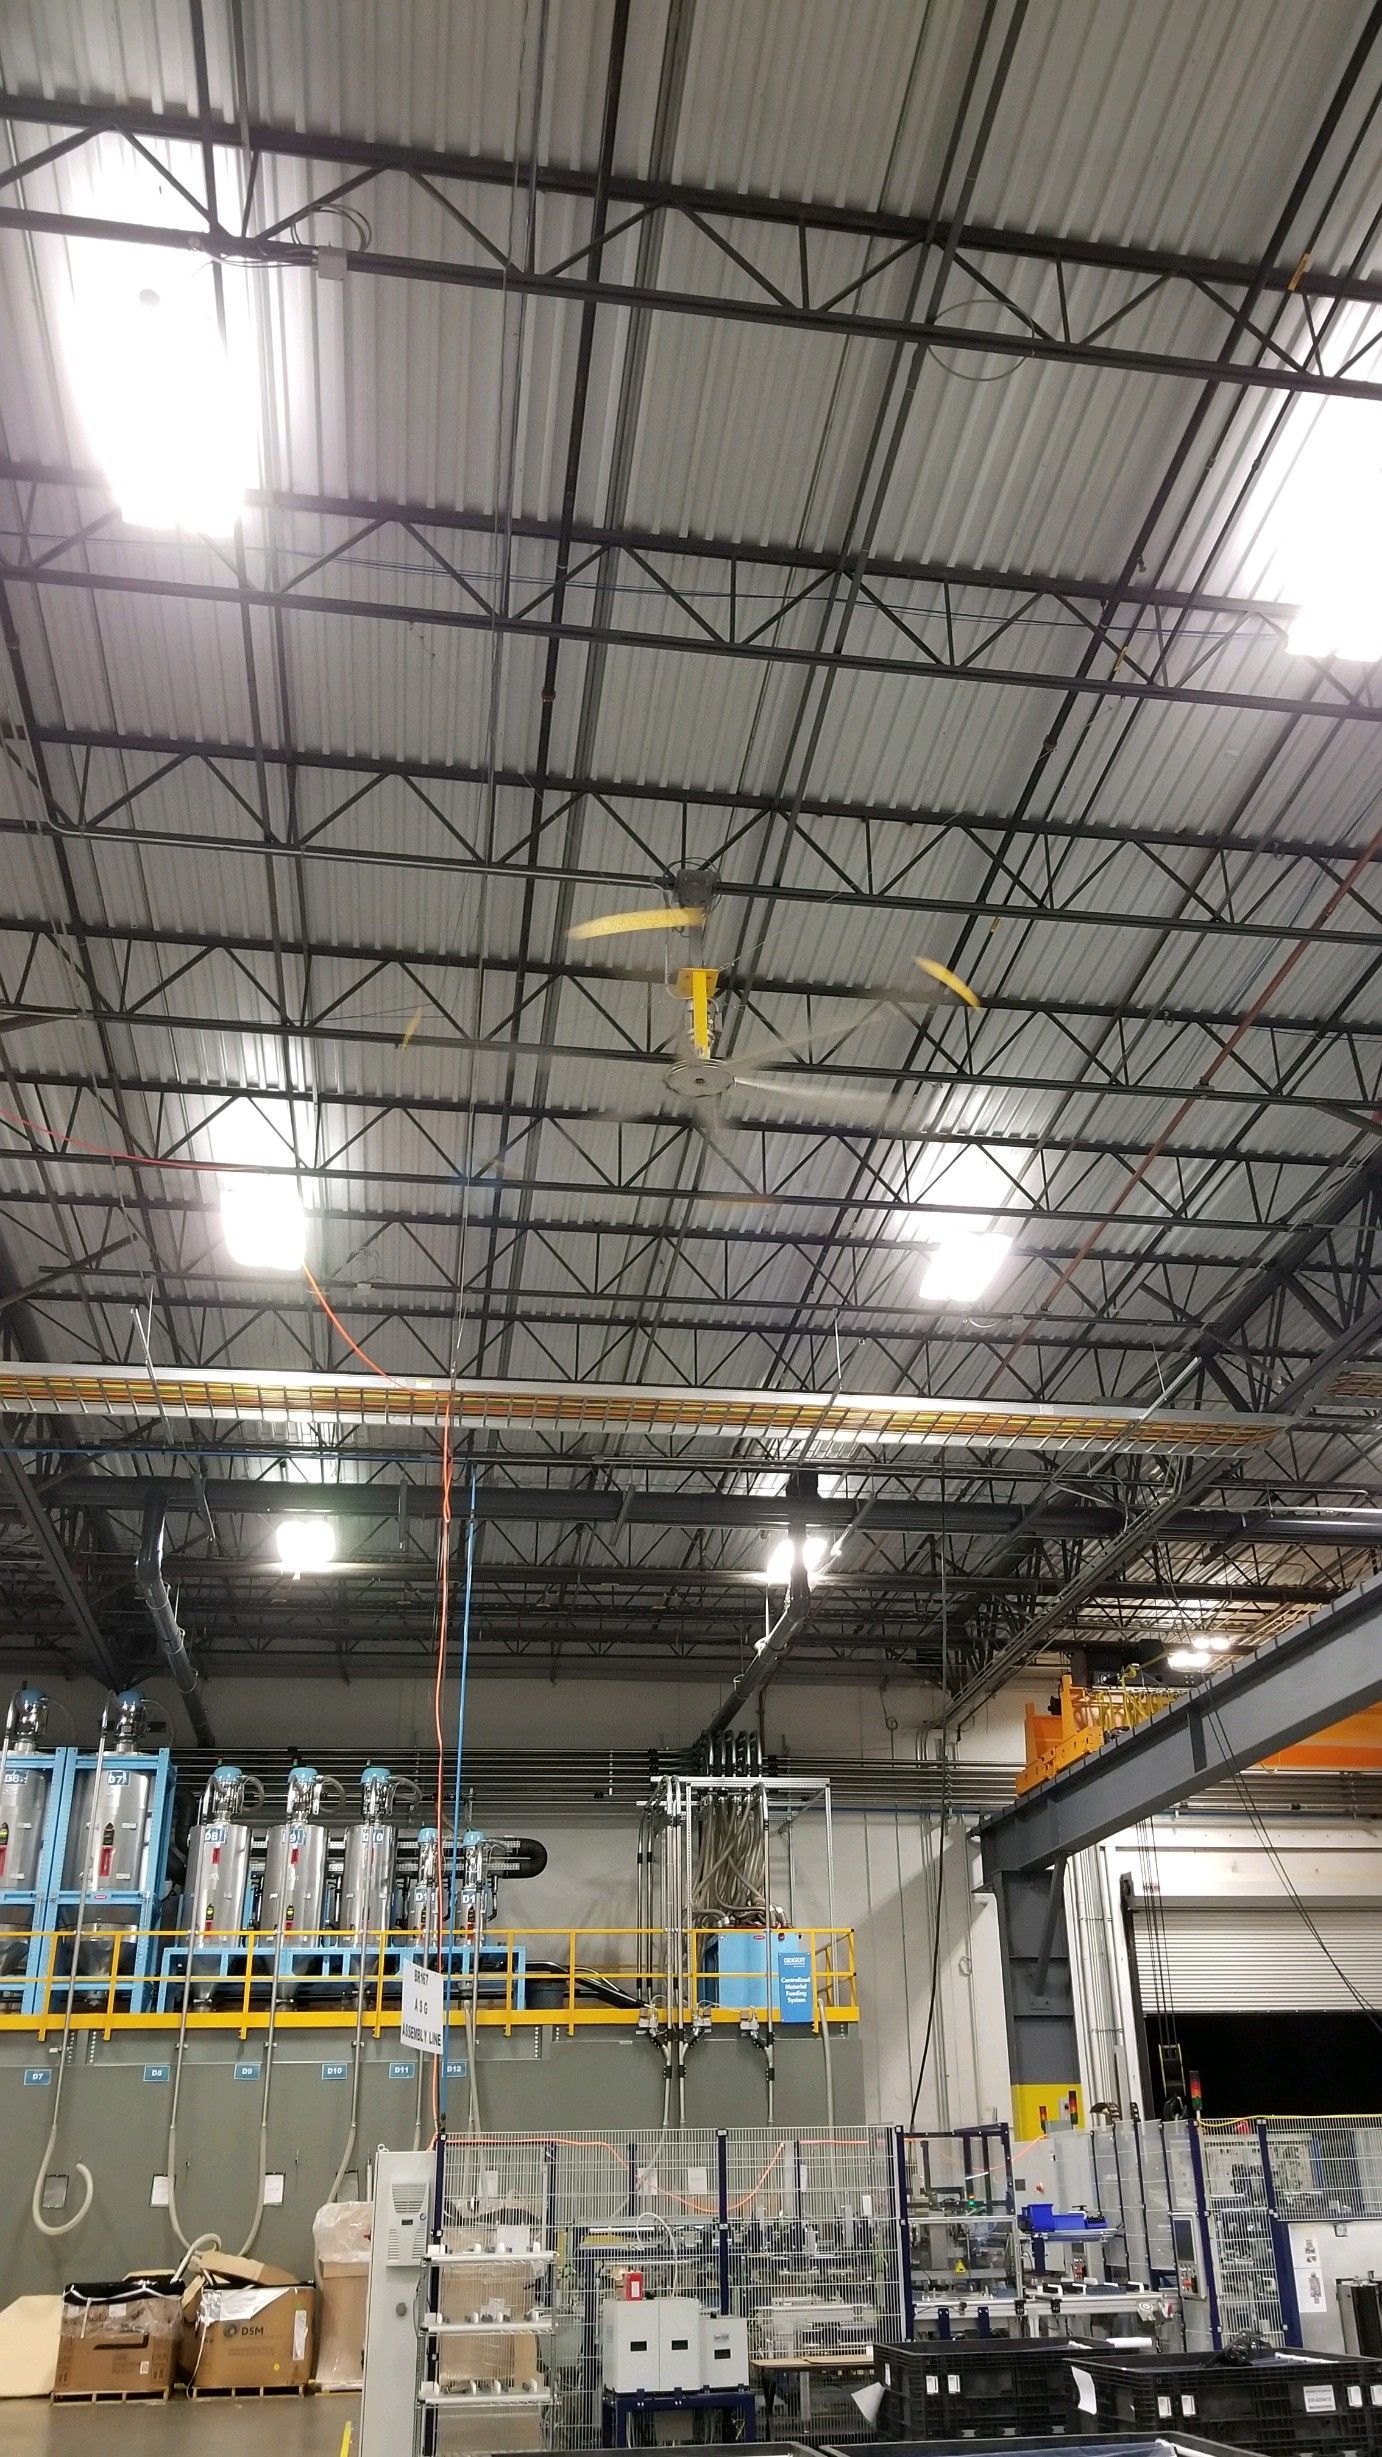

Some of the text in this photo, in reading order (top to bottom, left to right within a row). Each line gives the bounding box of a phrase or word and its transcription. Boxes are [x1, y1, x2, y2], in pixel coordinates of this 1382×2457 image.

[402, 2022, 442, 2047] ASSEMBLY LINE
[151, 2069, 163, 2077] D8
[241, 2067, 253, 2075] D9
[327, 2067, 343, 2075] D10
[394, 2066, 409, 2074] D11
[446, 2065, 462, 2073] D12
[32, 2073, 44, 2081] D7
[241, 2326, 264, 2336] DSM
